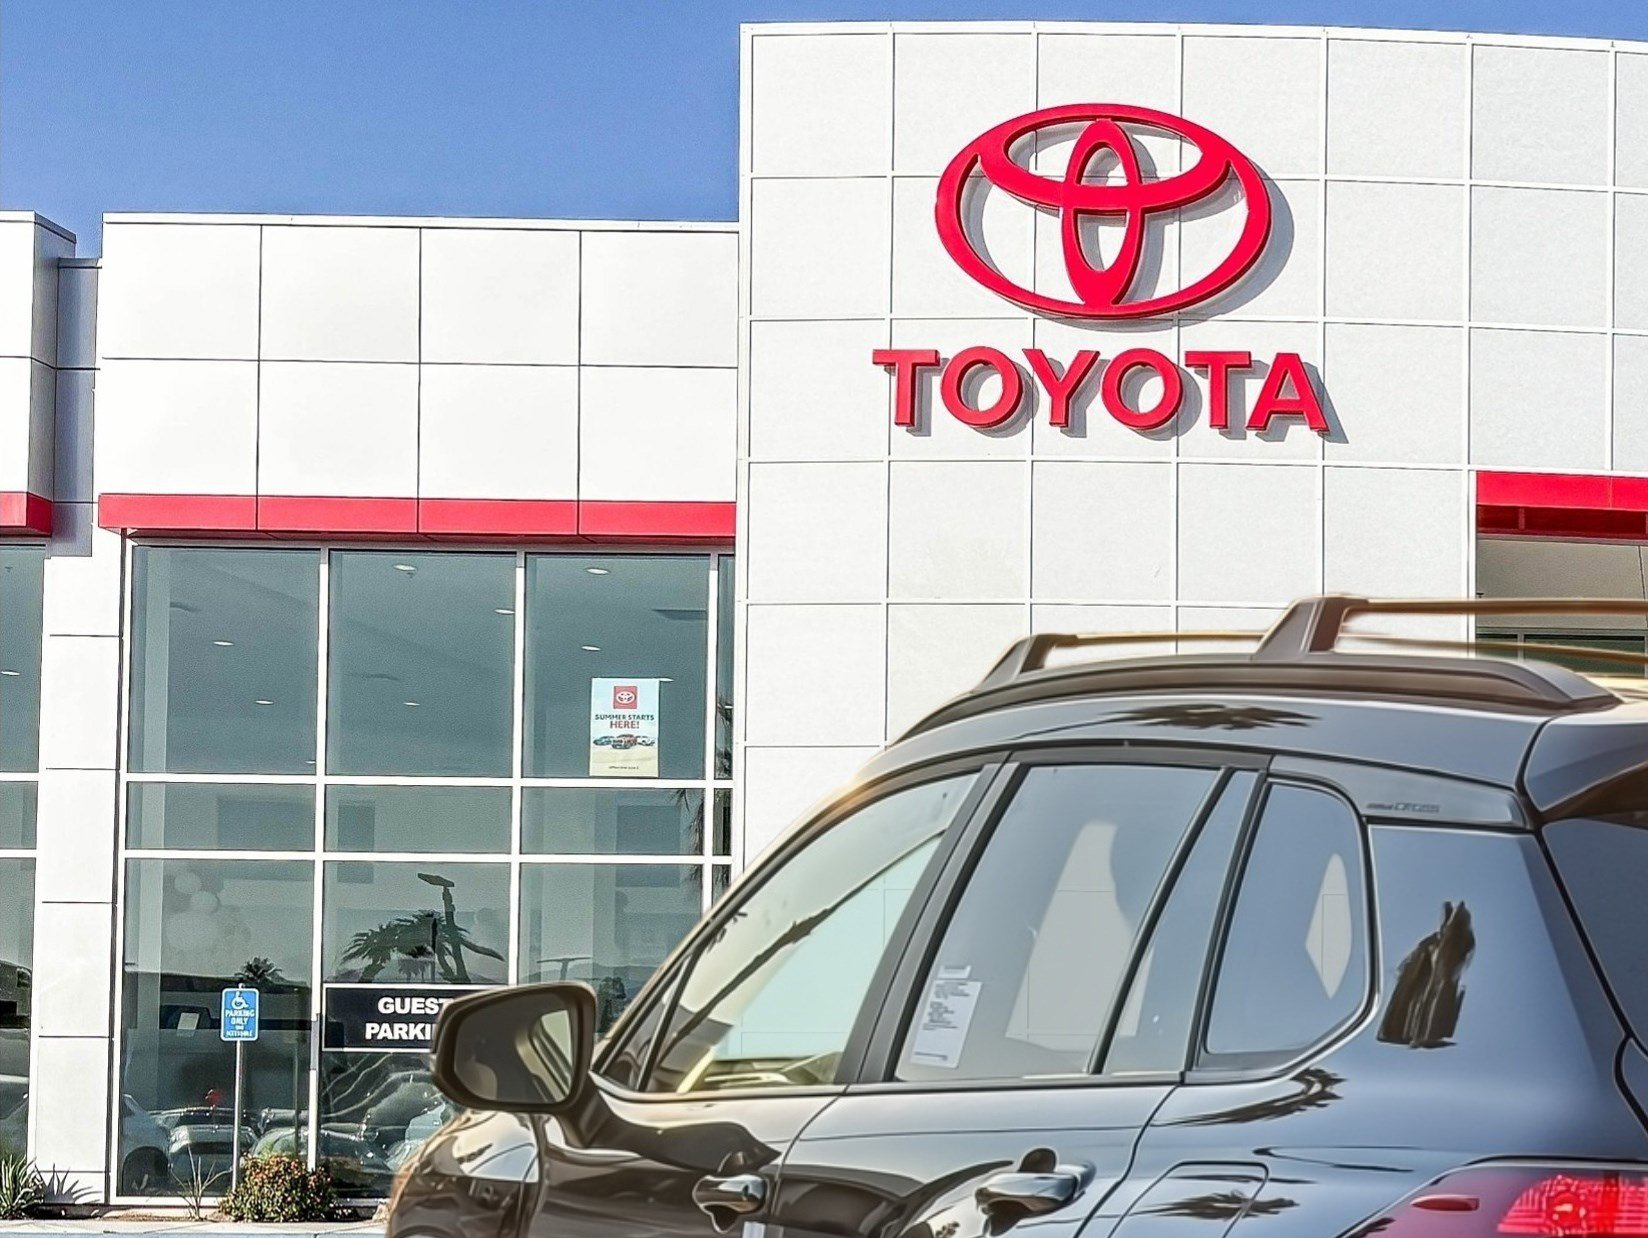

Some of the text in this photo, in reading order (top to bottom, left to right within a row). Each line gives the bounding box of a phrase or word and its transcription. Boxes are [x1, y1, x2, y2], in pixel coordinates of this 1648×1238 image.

[872, 345, 1330, 432] TOYOTA
[609, 720, 640, 729] HERE!
[365, 1022, 434, 1040] PARKI
